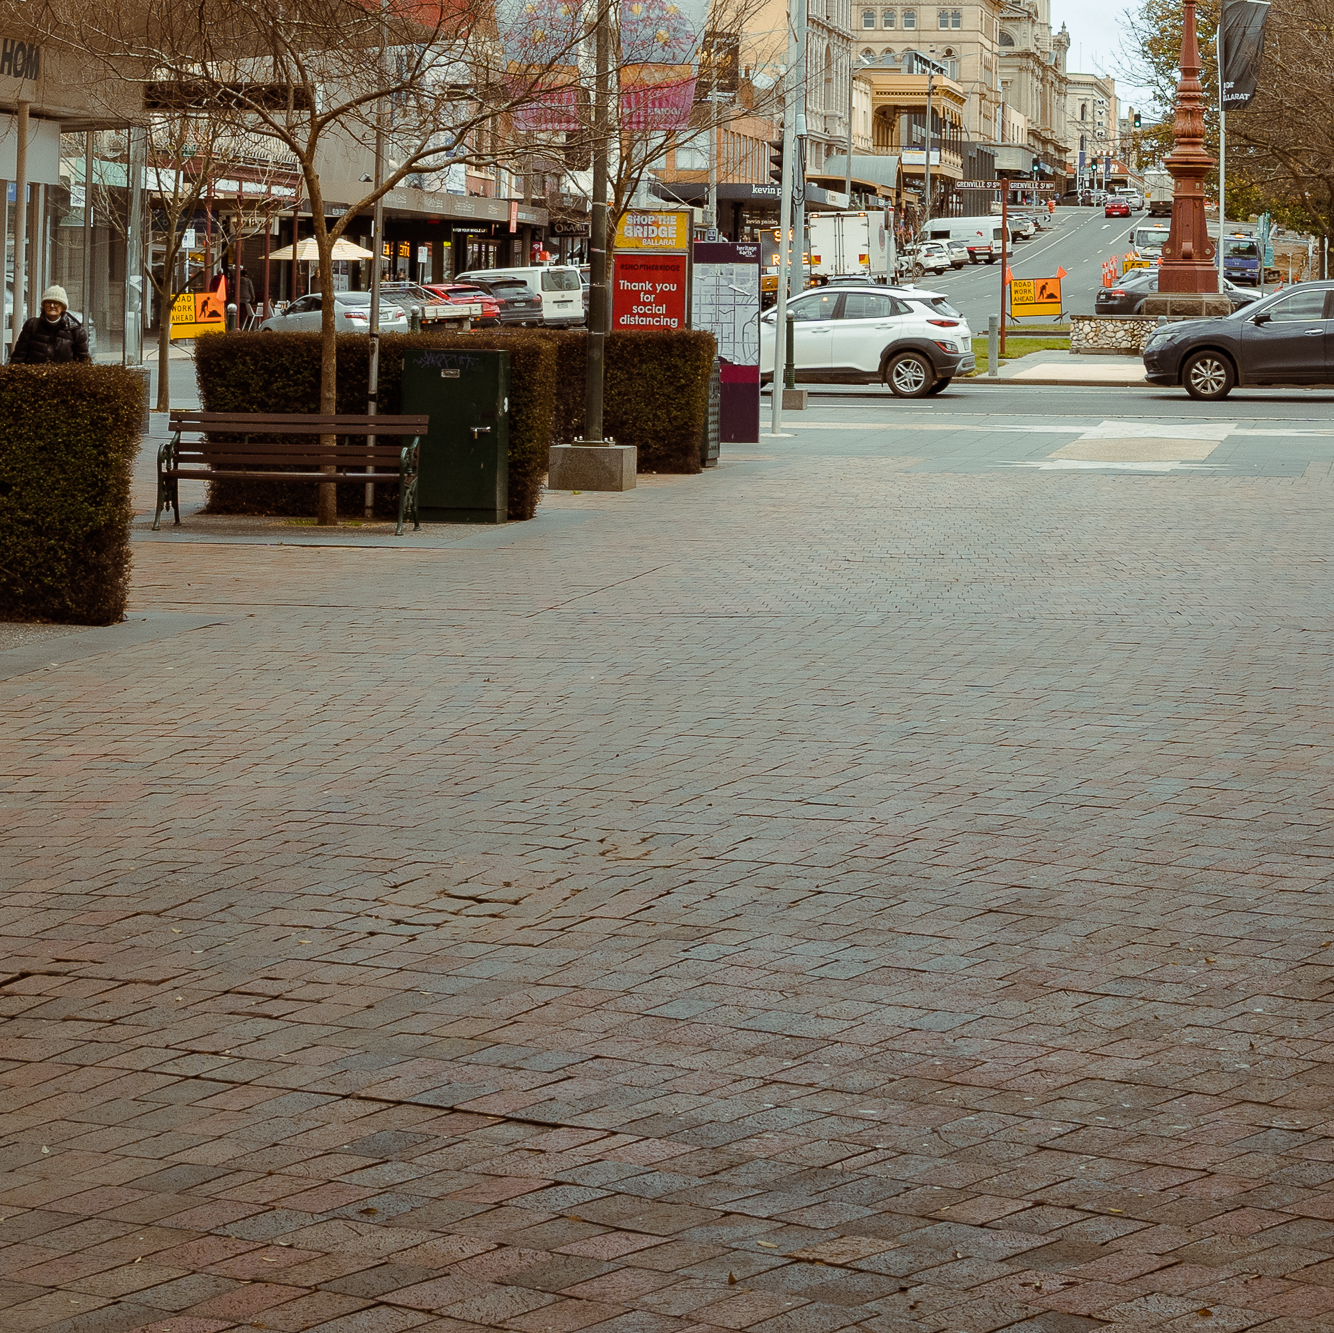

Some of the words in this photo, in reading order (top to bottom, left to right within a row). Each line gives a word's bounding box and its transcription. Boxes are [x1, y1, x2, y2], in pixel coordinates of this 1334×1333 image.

[956, 180, 985, 188] GRENVILLE
[752, 184, 775, 195] kevin
[625, 216, 657, 225] SHOP
[659, 215, 677, 225] THE
[623, 226, 677, 238] BRIDGE
[642, 238, 676, 246] BALLARAT
[619, 280, 655, 290] Thank
[655, 282, 677, 293] you
[640, 292, 655, 302] for
[632, 304, 666, 314] social
[171, 314, 194, 322] AHEAD
[619, 315, 679, 328] distancing
